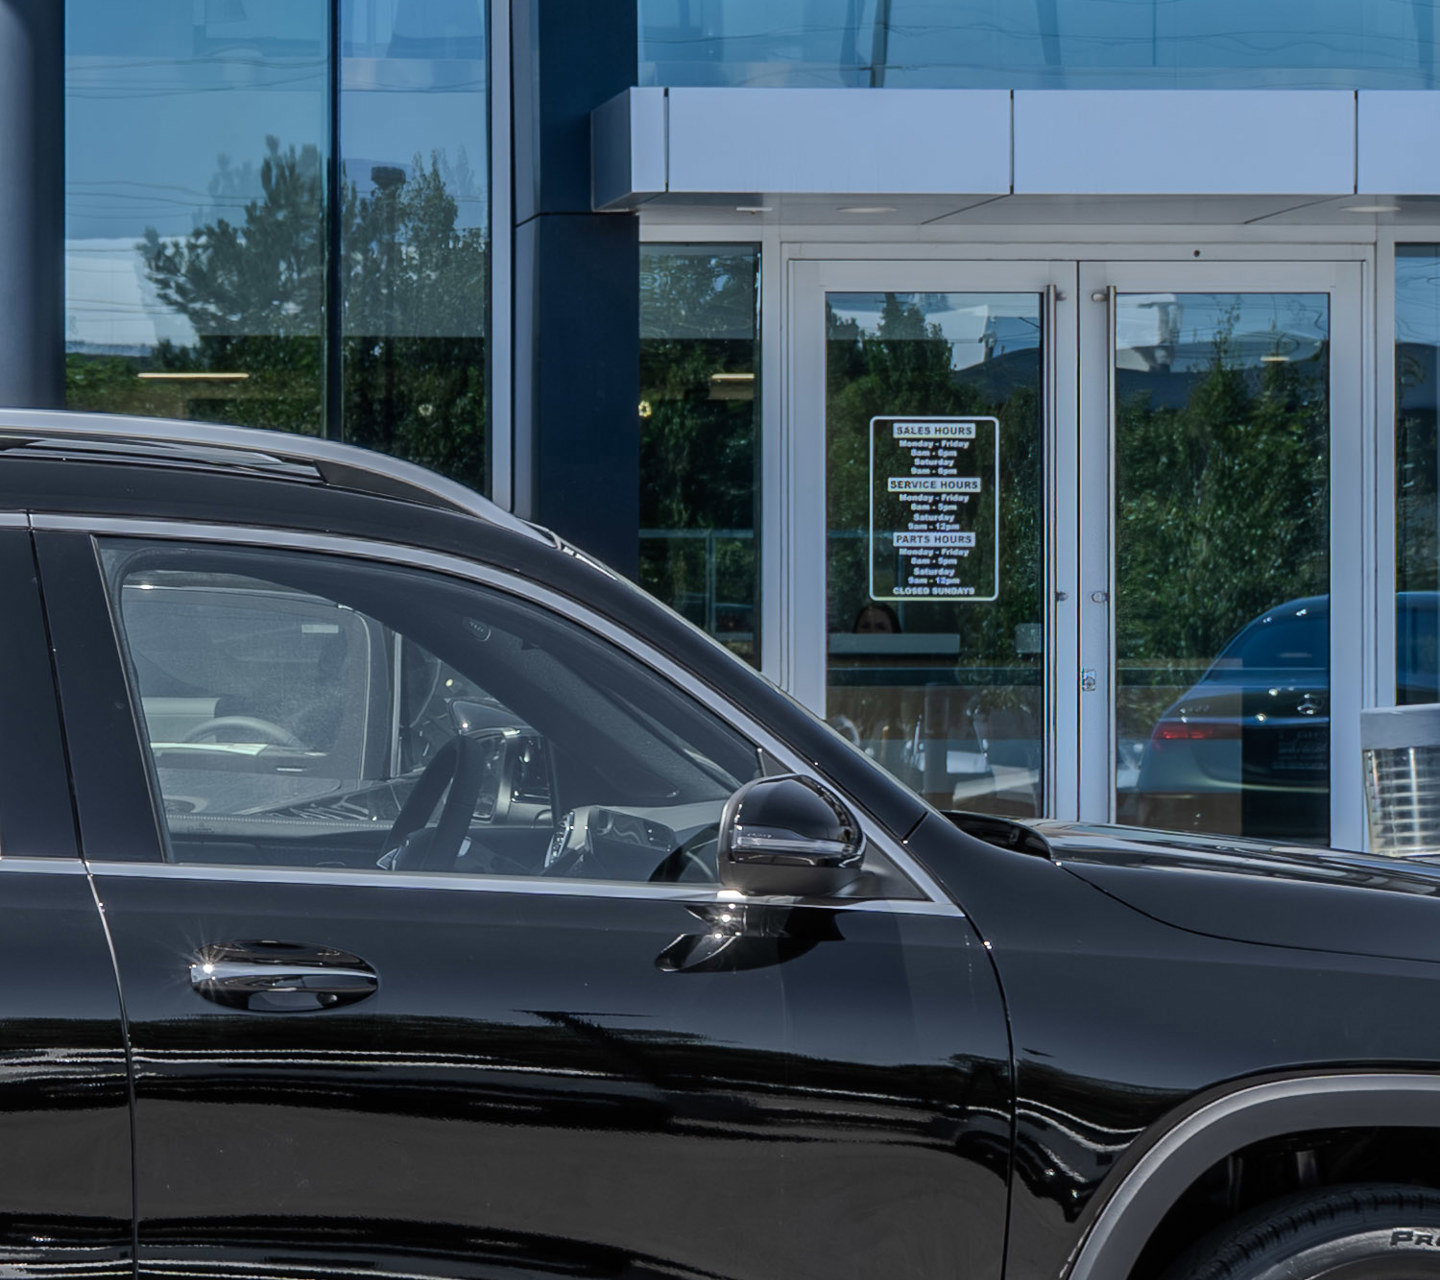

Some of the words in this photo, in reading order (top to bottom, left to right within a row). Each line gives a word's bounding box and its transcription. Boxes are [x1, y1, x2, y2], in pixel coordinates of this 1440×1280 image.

[896, 426, 931, 435] SALES
[934, 426, 972, 435] HOURS
[899, 440, 934, 449] Monday
[941, 440, 970, 449] Friday
[914, 458, 954, 467] Saturday
[890, 480, 937, 489] SERVICE
[940, 480, 978, 489] HOURS
[899, 494, 934, 503] Monday
[941, 494, 970, 503] Friday
[913, 513, 955, 522] Saturday
[935, 522, 960, 531] 12pm
[896, 535, 931, 544] PARTS
[934, 535, 972, 544] HOURS
[899, 548, 934, 557] Monday
[941, 548, 970, 557] Friday
[913, 567, 955, 577] Saturday
[893, 587, 930, 595] CLOSED
[932, 587, 975, 595] SUNDAYS
